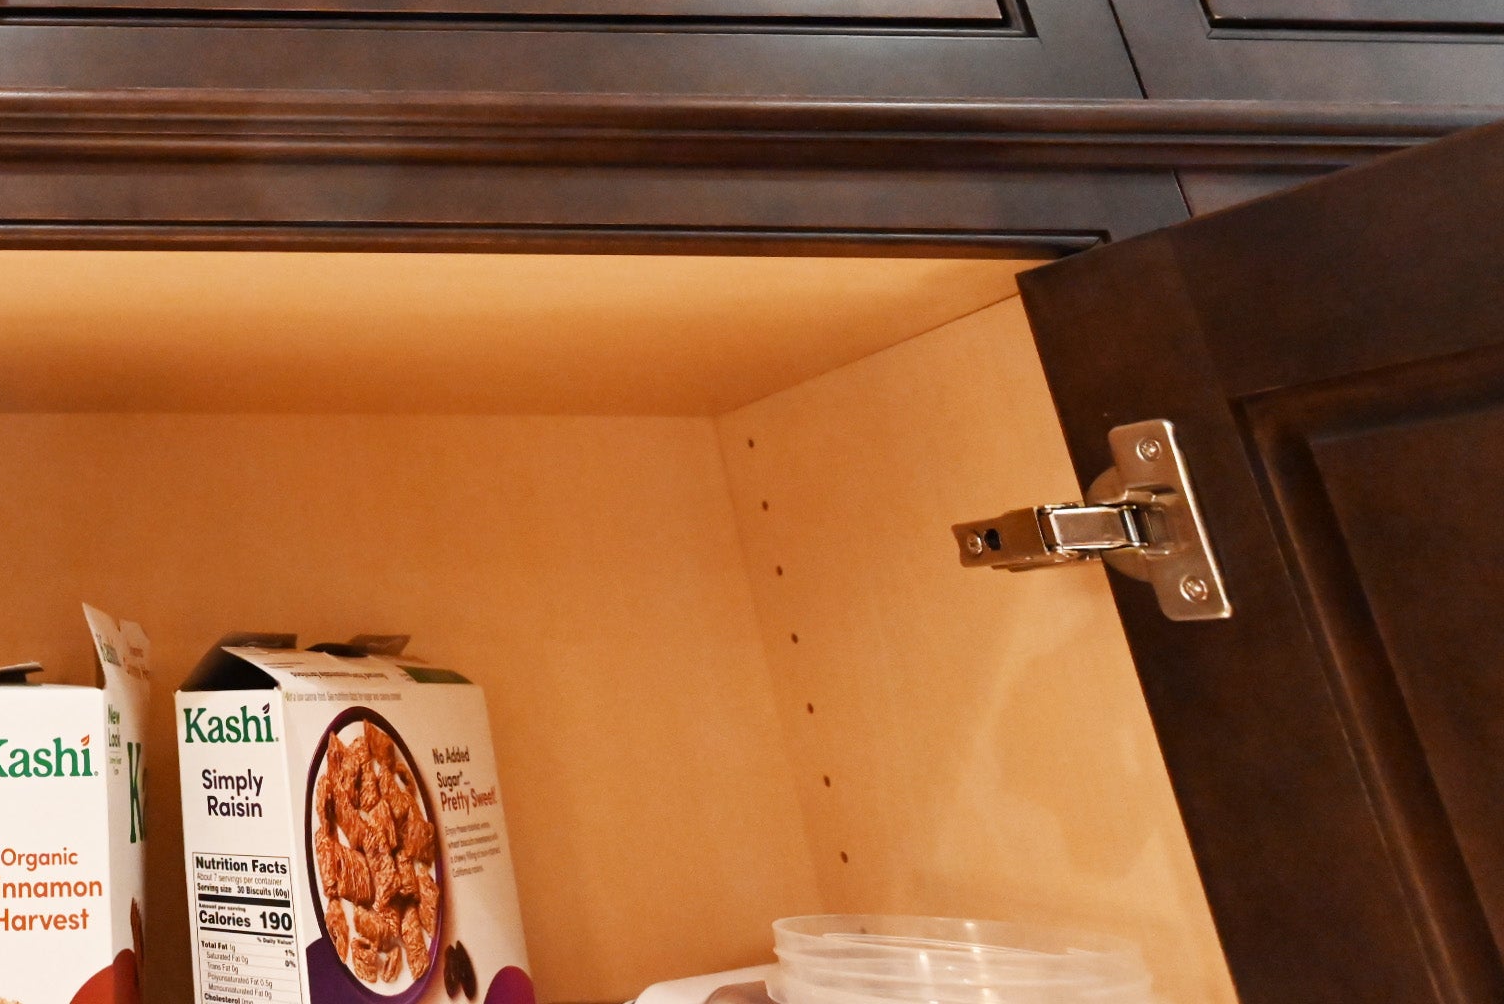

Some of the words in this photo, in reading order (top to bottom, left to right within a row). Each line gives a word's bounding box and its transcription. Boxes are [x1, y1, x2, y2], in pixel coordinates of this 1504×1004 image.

[183, 702, 275, 744] Kashi
[432, 747, 444, 764] No
[445, 745, 470, 764] Added
[201, 768, 264, 797] Simply
[207, 795, 263, 817] Raisin
[440, 791, 470, 816] Pretty
[0, 847, 79, 872] Organic
[195, 856, 248, 872] Nutrition
[251, 859, 287, 875] Facts
[197, 872, 213, 881] About
[218, 874, 243, 885] servings
[243, 876, 253, 885] per
[254, 876, 282, 886] container
[197, 882, 219, 893] Serving
[220, 884, 232, 893] size
[237, 885, 245, 894] 30
[246, 886, 272, 896] Biscuits
[199, 910, 251, 927] Calories
[259, 911, 293, 931] 190
[201, 940, 217, 949] Total
[217, 942, 228, 950] Fat
[284, 949, 295, 957] 1%
[206, 951, 231, 961] Saturated
[284, 960, 296, 968] 0%
